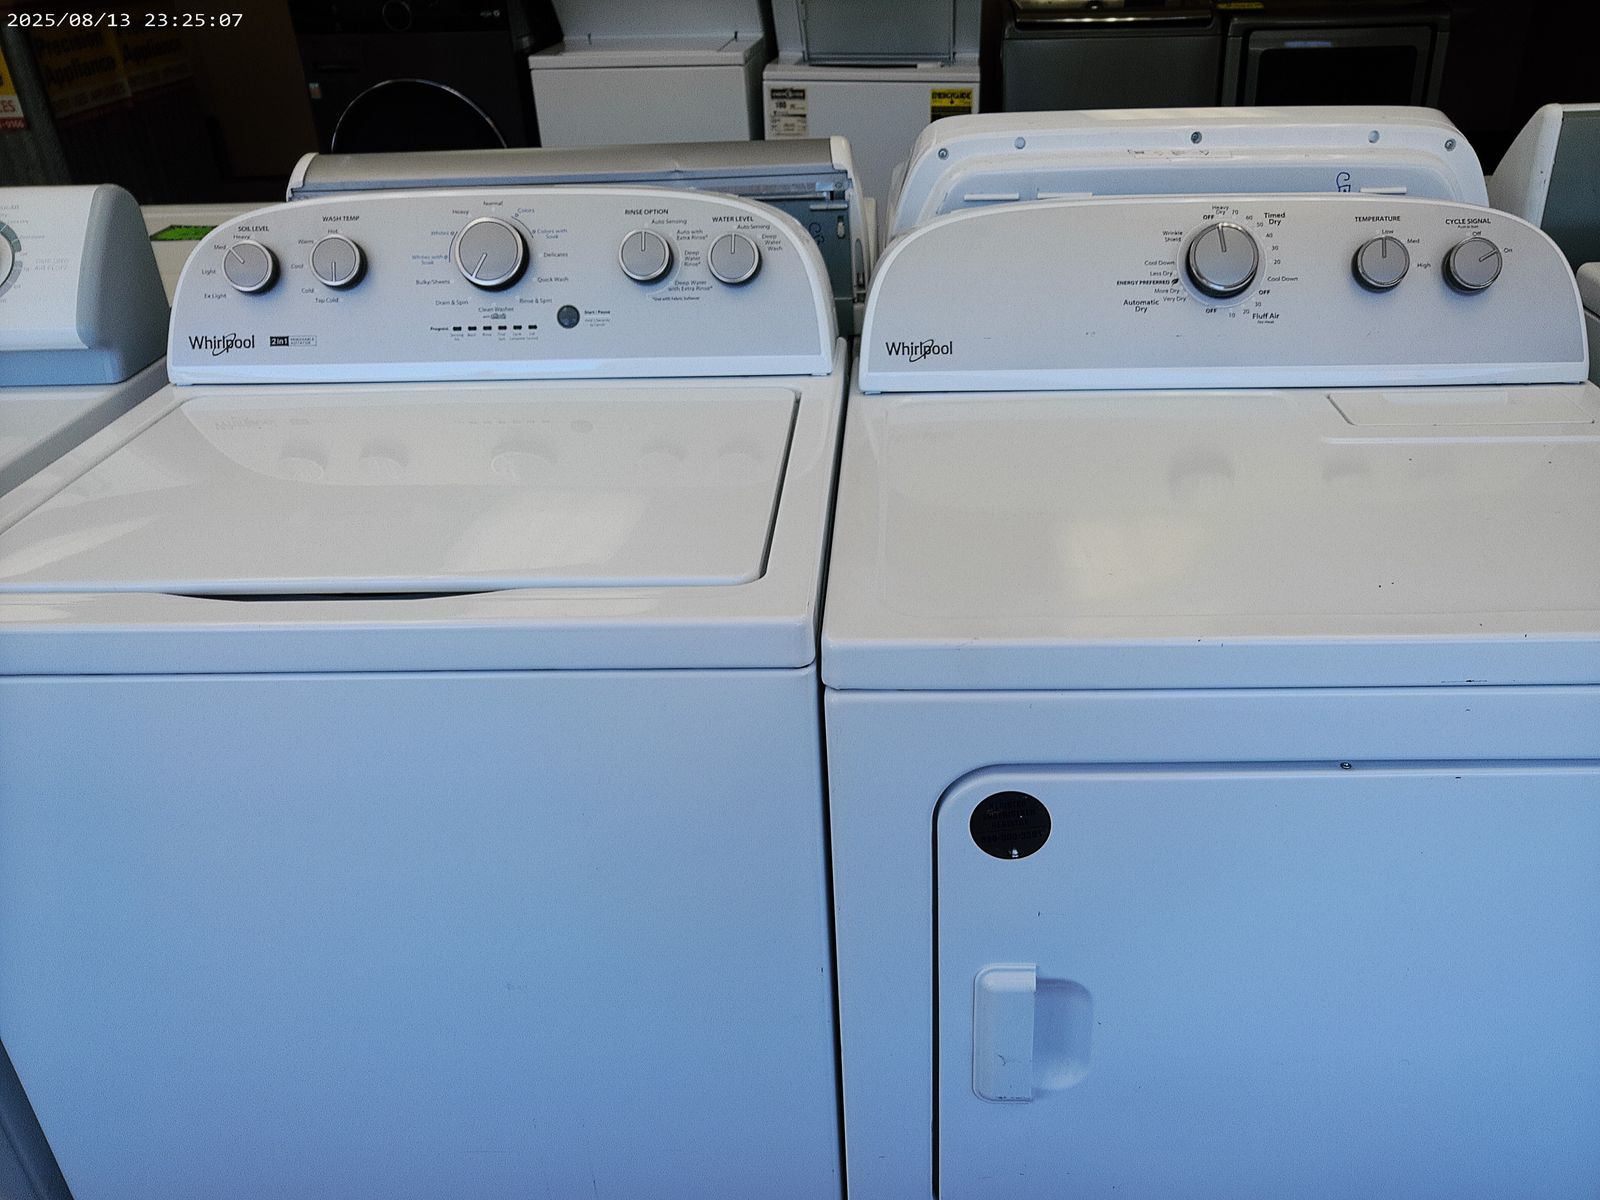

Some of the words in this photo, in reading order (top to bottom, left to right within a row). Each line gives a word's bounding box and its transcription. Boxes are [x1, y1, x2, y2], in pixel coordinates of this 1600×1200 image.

[45, 56, 117, 86] Appliance
[188, 333, 255, 356] Whirlpool
[886, 339, 953, 362] Whirlpool
